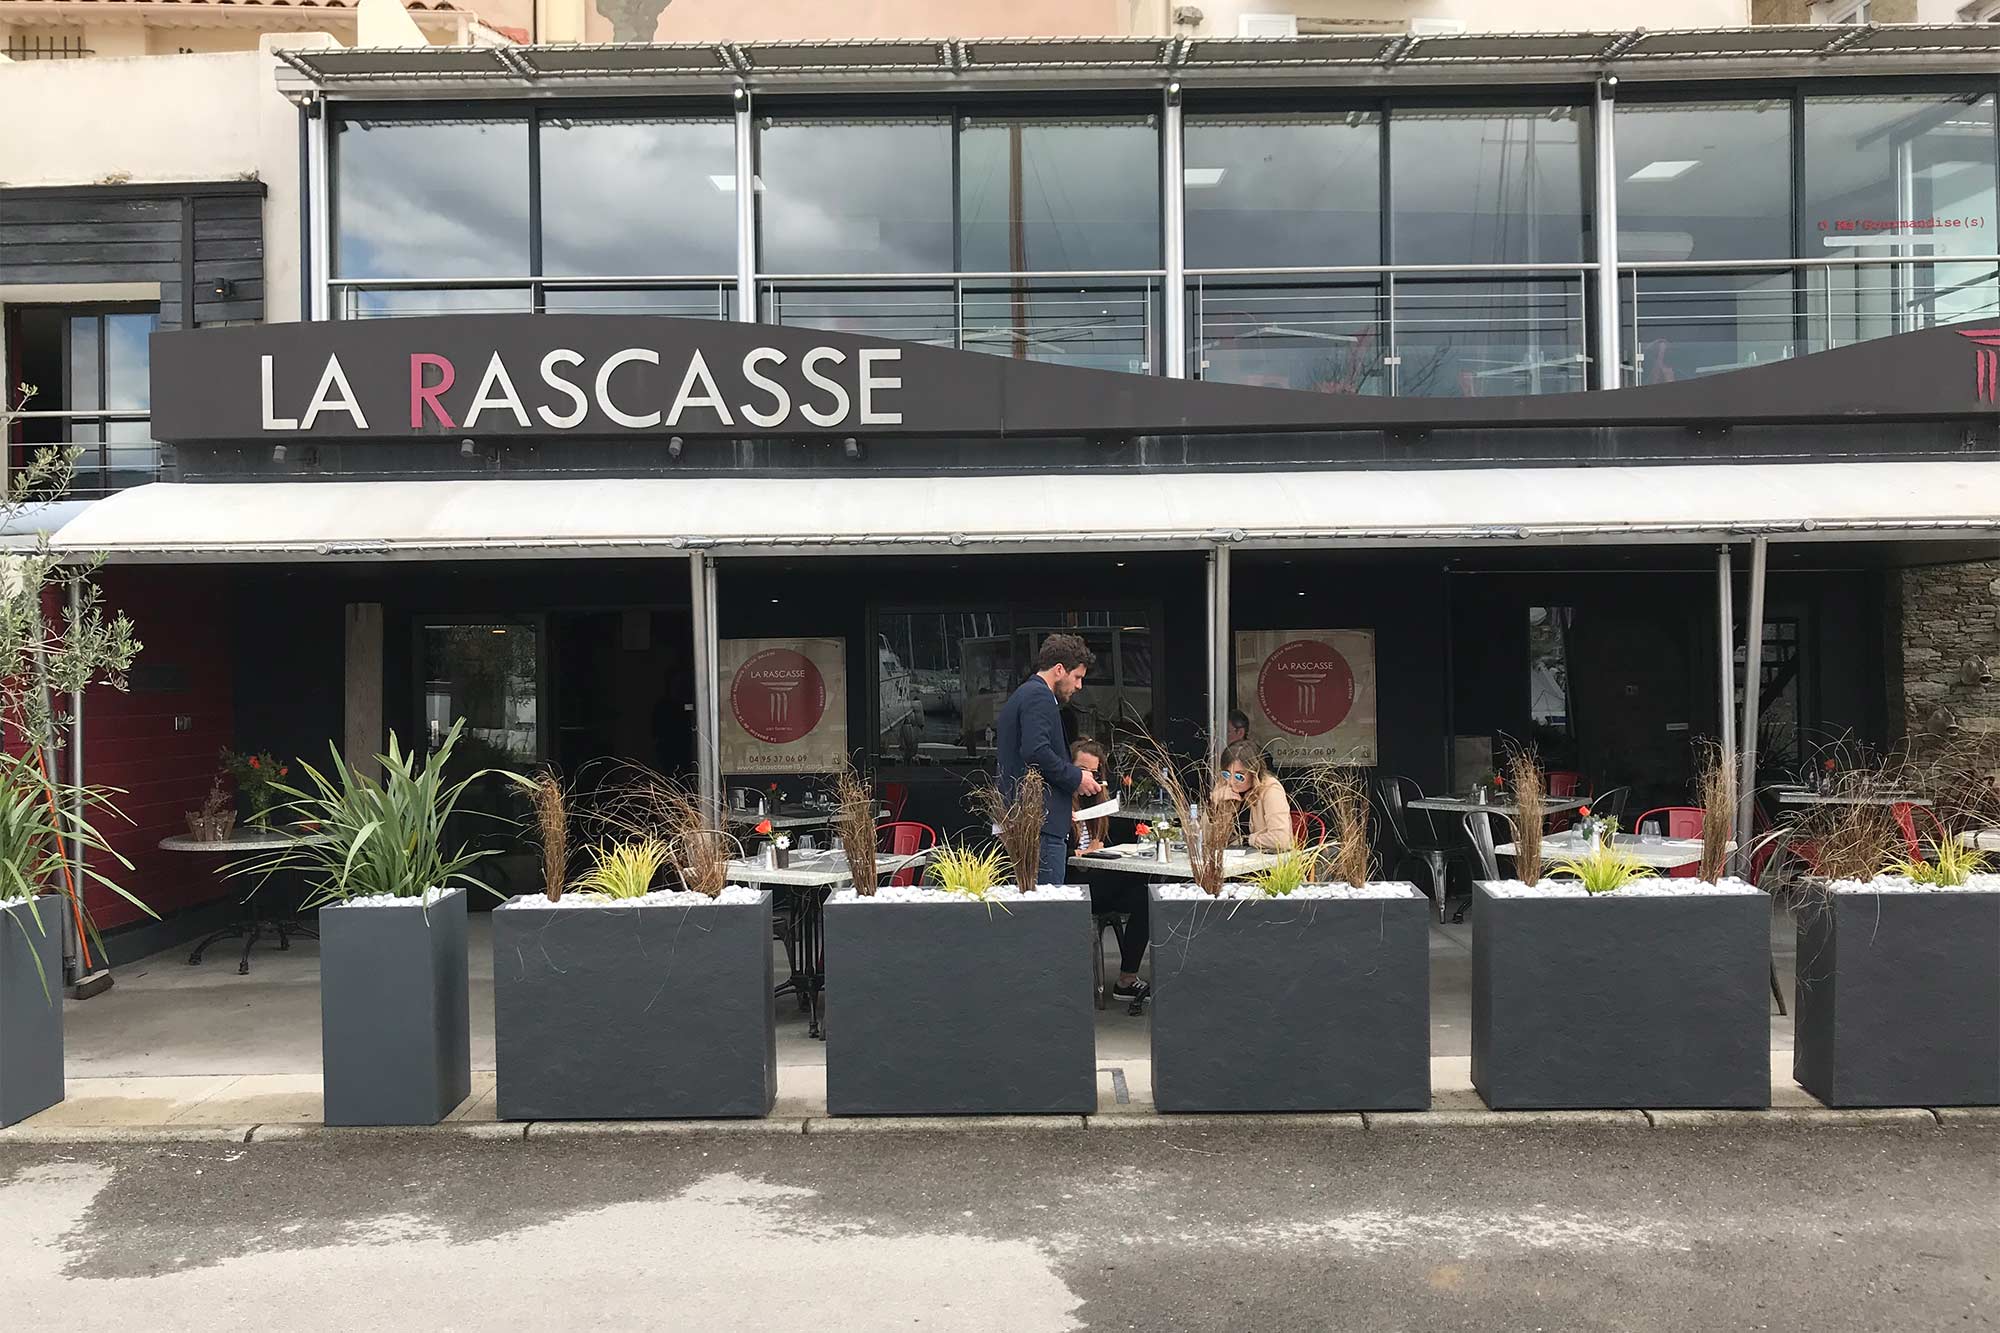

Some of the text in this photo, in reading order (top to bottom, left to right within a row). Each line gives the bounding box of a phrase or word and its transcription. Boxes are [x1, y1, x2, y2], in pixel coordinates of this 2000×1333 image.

[261, 346, 904, 431] LA RASCASSE
[1291, 661, 1333, 670] RASCASSE
[750, 669, 806, 679] LA RASCASSE
[749, 755, 759, 763] 04
[761, 755, 772, 763] 95
[797, 754, 807, 762] 09
